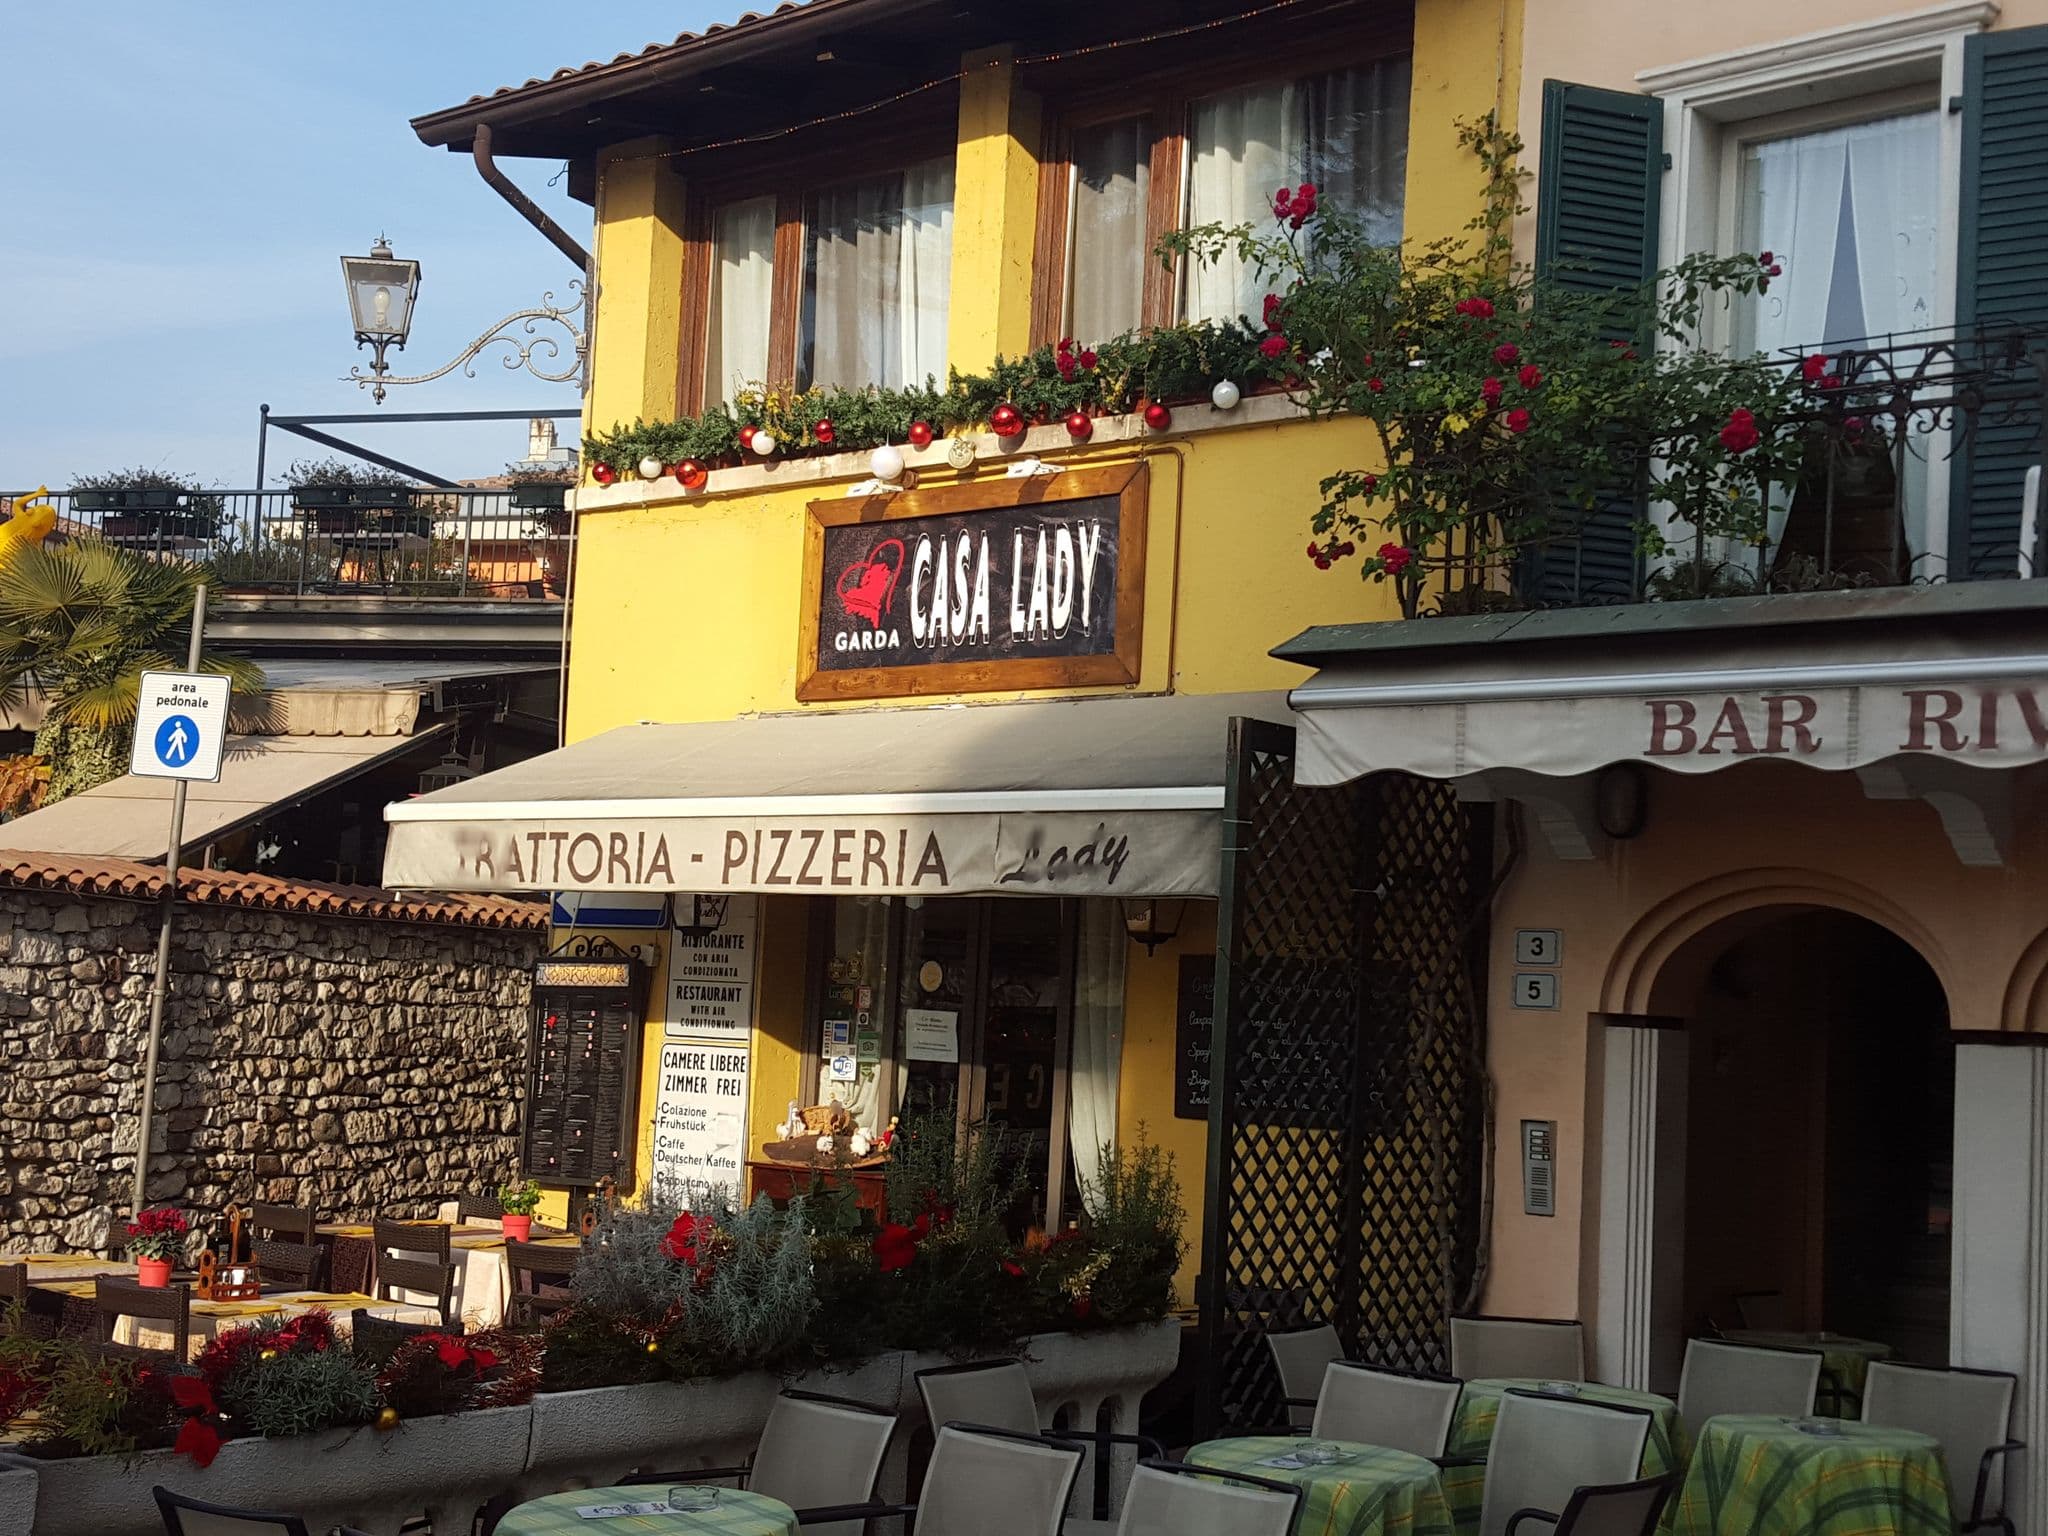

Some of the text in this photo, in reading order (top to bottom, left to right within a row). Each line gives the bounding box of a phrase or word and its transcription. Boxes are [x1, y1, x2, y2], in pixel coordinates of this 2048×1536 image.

[910, 518, 1101, 648] CASA LADY
[834, 628, 901, 652] GARDA
[171, 683, 197, 694] area
[156, 695, 209, 708] pedonale
[1643, 694, 1823, 756] BAR
[455, 830, 674, 885] RATTORIA
[721, 828, 950, 887] PIZZERIA
[1530, 936, 1544, 957] 3
[692, 953, 729, 965] CON ARIA
[682, 965, 739, 978] CONDIZIONATA
[676, 984, 743, 1003] RESTAURANT
[1527, 980, 1541, 1001] 5
[690, 1005, 727, 1017] WITH AIR
[680, 1017, 736, 1030] CONDITIONING
[663, 1051, 747, 1073] CAMERE LIBERE
[665, 1074, 741, 1097] ZIMMER FREI
[660, 1101, 707, 1118] Colazione
[657, 1149, 737, 1169] Deutscher Kaffee
